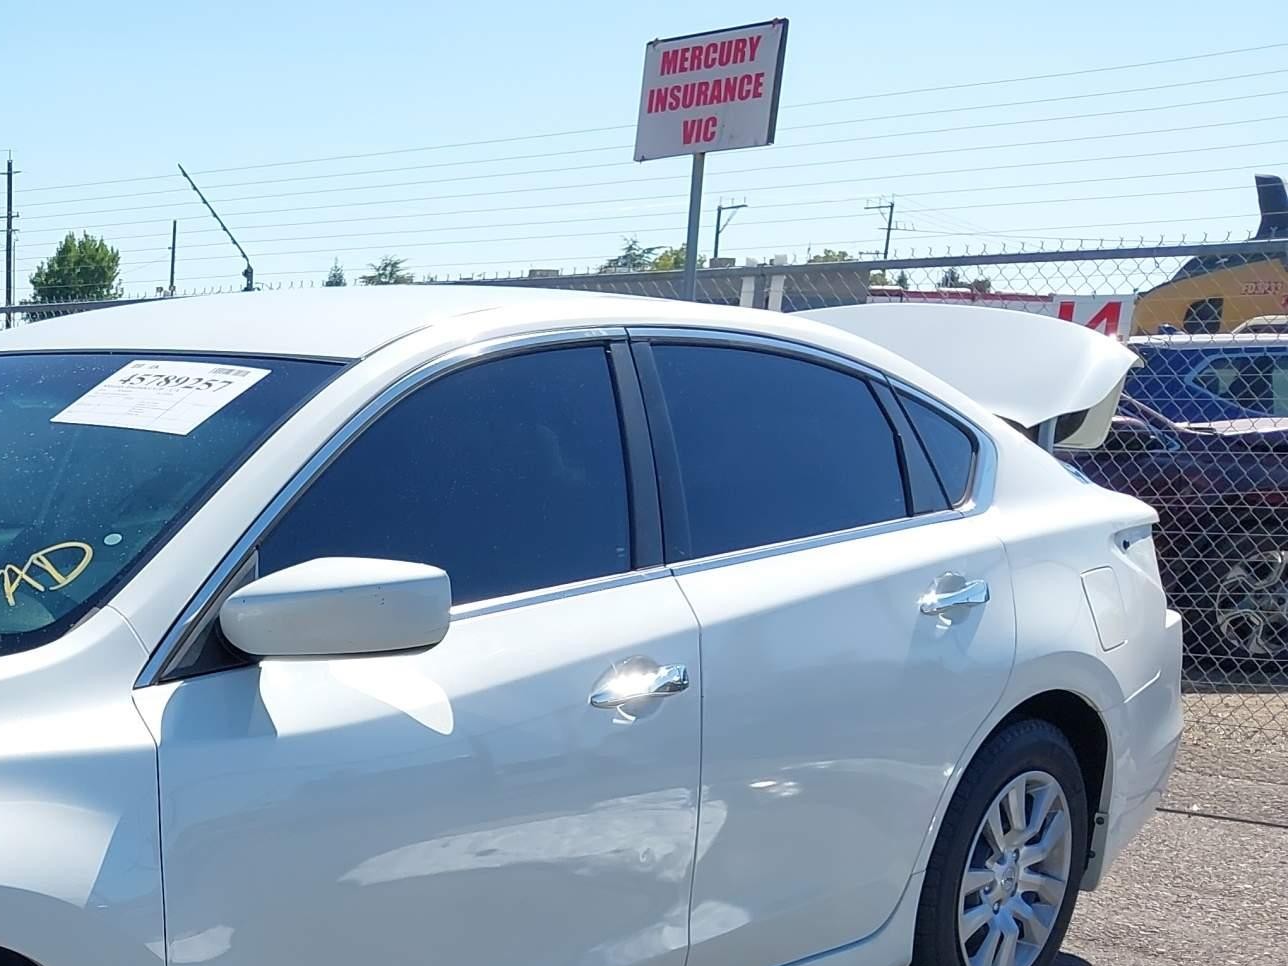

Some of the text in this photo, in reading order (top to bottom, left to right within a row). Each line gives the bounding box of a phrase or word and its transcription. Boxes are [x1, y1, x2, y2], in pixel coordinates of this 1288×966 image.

[660, 35, 762, 77] MERCURY
[647, 72, 765, 114] INSURANCE
[682, 116, 718, 145] VIC
[119, 373, 234, 393] 45789257
